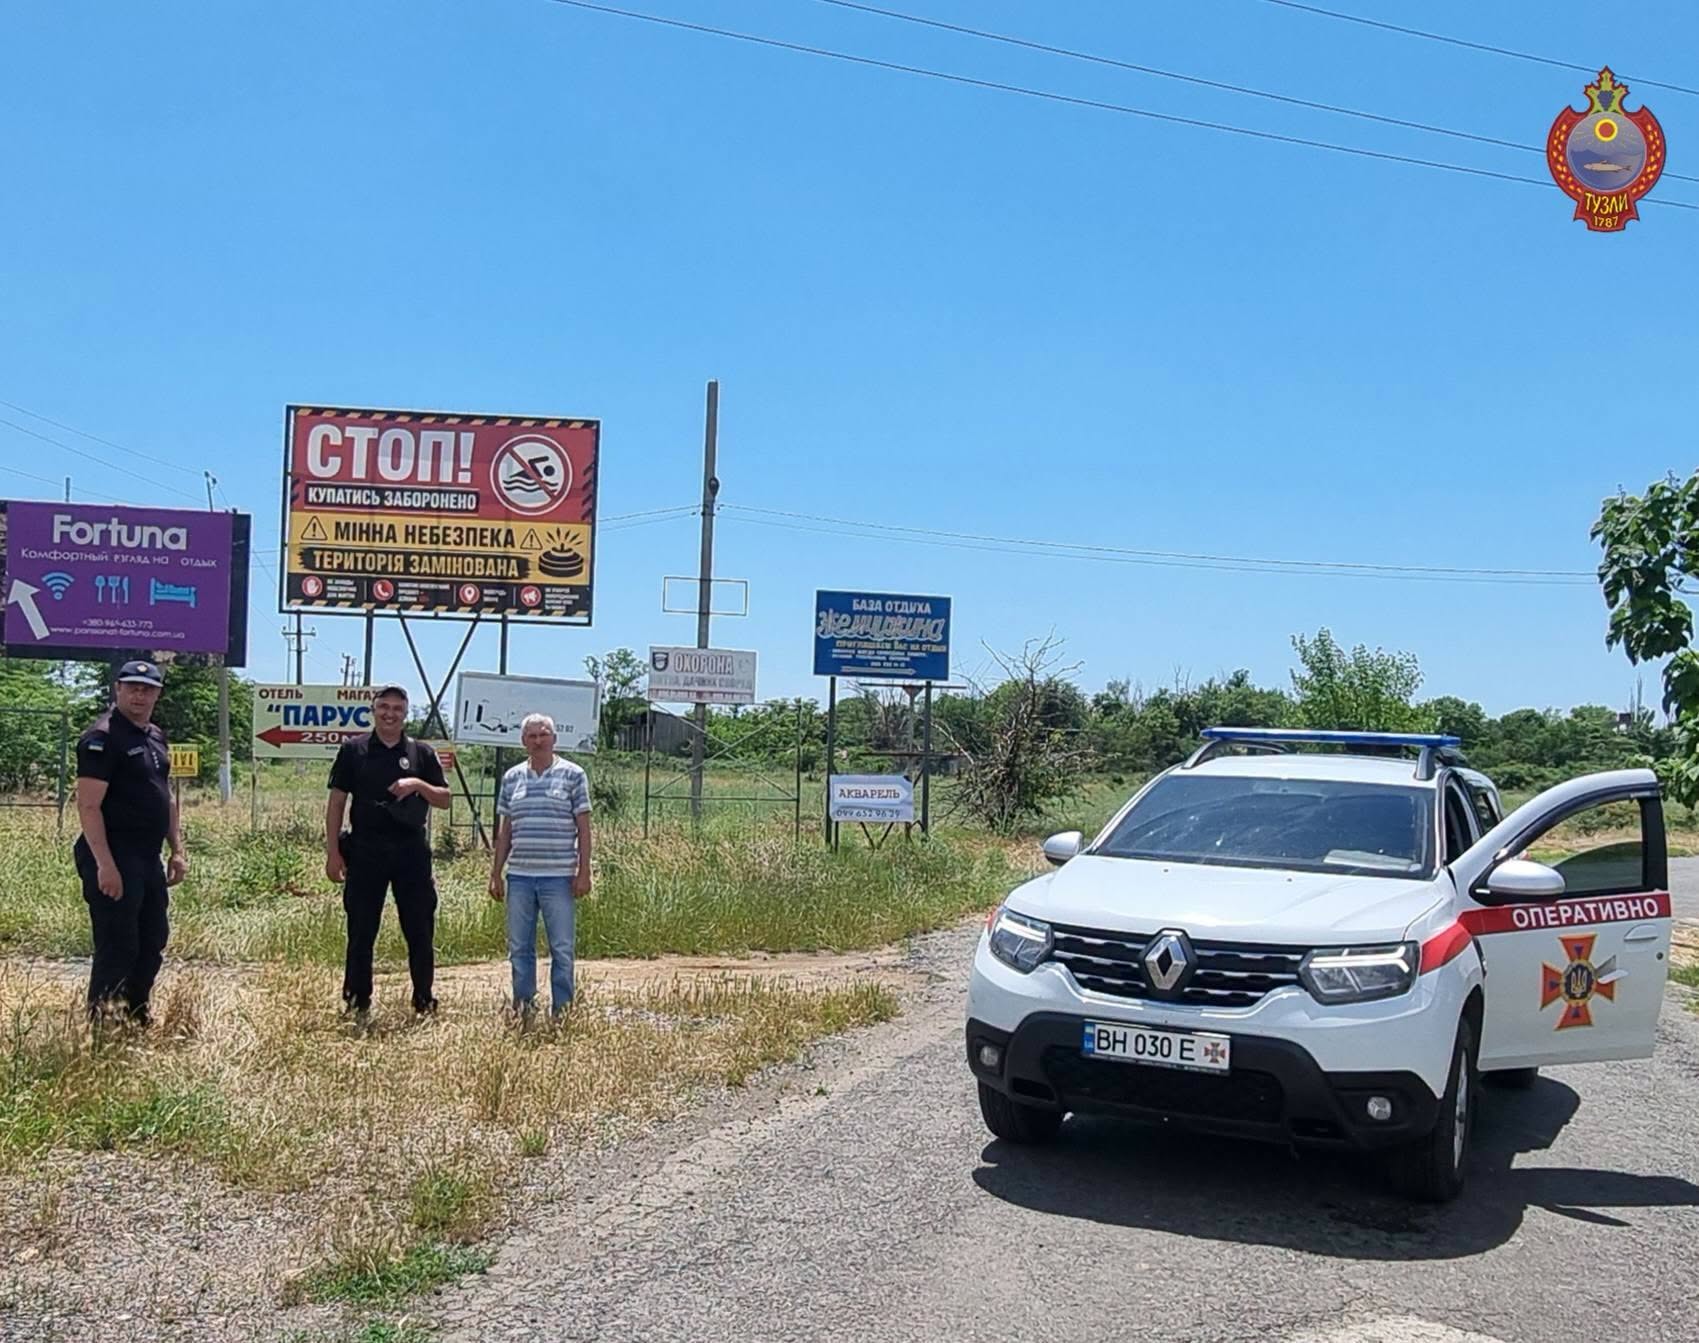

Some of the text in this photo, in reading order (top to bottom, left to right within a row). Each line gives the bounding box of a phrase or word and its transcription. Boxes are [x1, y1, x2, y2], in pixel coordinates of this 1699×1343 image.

[306, 423, 475, 484] СТОП!
[308, 485, 477, 511] КУПАТИСЬ ЗАБОРОНЕНО
[52, 513, 188, 551] Fortuna
[334, 521, 516, 549] МІННА НЕБЕЗПЕКА
[21, 547, 109, 563] Комфортный
[180, 557, 218, 568] отдых
[313, 550, 519, 578] ТЕРИТОРІЯ ЗАМІНОВАНА
[852, 598, 883, 612] БАЗА
[674, 653, 734, 675] ОХОРОНА
[258, 688, 303, 700] ОТЕЛЬ
[838, 788, 900, 799] АКВАРЕЛЬ
[1512, 899, 1659, 928] ОПЕРАТИВНО
[1134, 1033, 1172, 1058] 030
